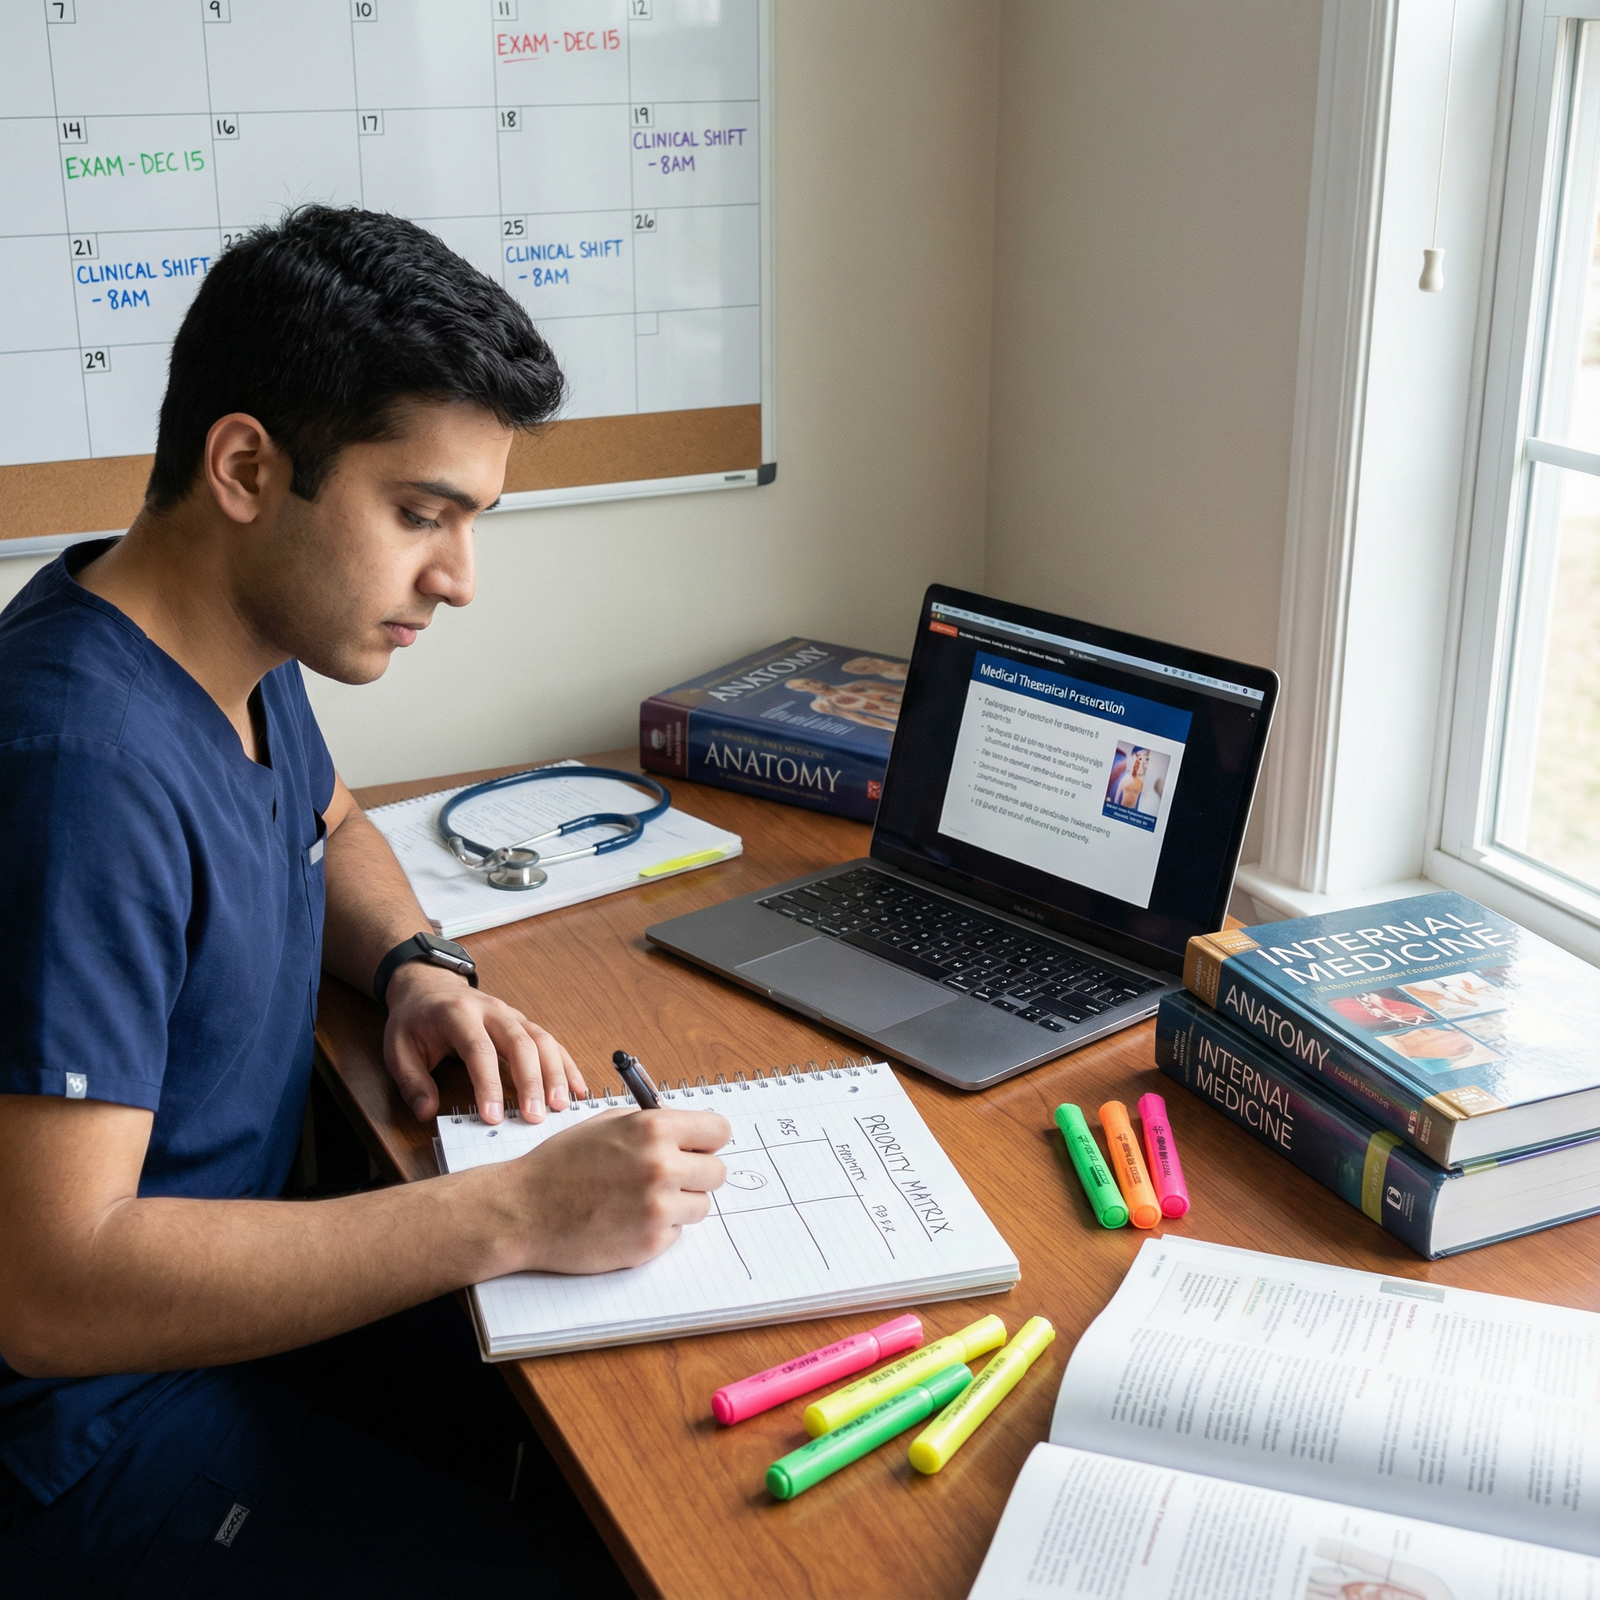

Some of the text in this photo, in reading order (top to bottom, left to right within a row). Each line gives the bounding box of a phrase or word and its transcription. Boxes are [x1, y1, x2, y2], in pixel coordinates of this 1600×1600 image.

[52, 2, 64, 19] 7
[209, 0, 221, 18] 9
[355, 1, 373, 17] 10
[632, 0, 648, 16] 12
[498, 33, 549, 56] EXAM
[563, 31, 597, 52] DEC
[602, 29, 620, 50] 15
[361, 115, 378, 132] 17
[501, 110, 517, 128] 18
[634, 106, 650, 124] 19
[62, 121, 82, 140] 14
[216, 119, 236, 136] 16
[633, 128, 748, 150] CLINICAL SHIFT
[65, 154, 125, 180] EXAM
[140, 151, 179, 175] DEC
[184, 150, 205, 172] 15
[660, 155, 696, 175] 8AM
[503, 219, 525, 236] 25
[634, 214, 655, 230] 26
[73, 239, 93, 256] 21
[505, 239, 624, 264] CLINICAL SHIFT
[76, 256, 211, 285] CLINICAL SHIFT
[532, 267, 570, 287] 8AM
[106, 288, 151, 311] 8AM
[84, 351, 106, 370] 29
[708, 646, 829, 702] ANATOMY
[980, 663, 1018, 684] Medical
[704, 742, 842, 793] ANATOMY
[1256, 913, 1484, 966] INTERNAL
[1282, 928, 1515, 985] MEDICINE
[1224, 984, 1330, 1073] ANATOMY
[1198, 1036, 1294, 1121] INTERNAL
[1197, 1064, 1292, 1150] MEDICINE
[861, 1114, 954, 1234] PRIORITY MATRIX
